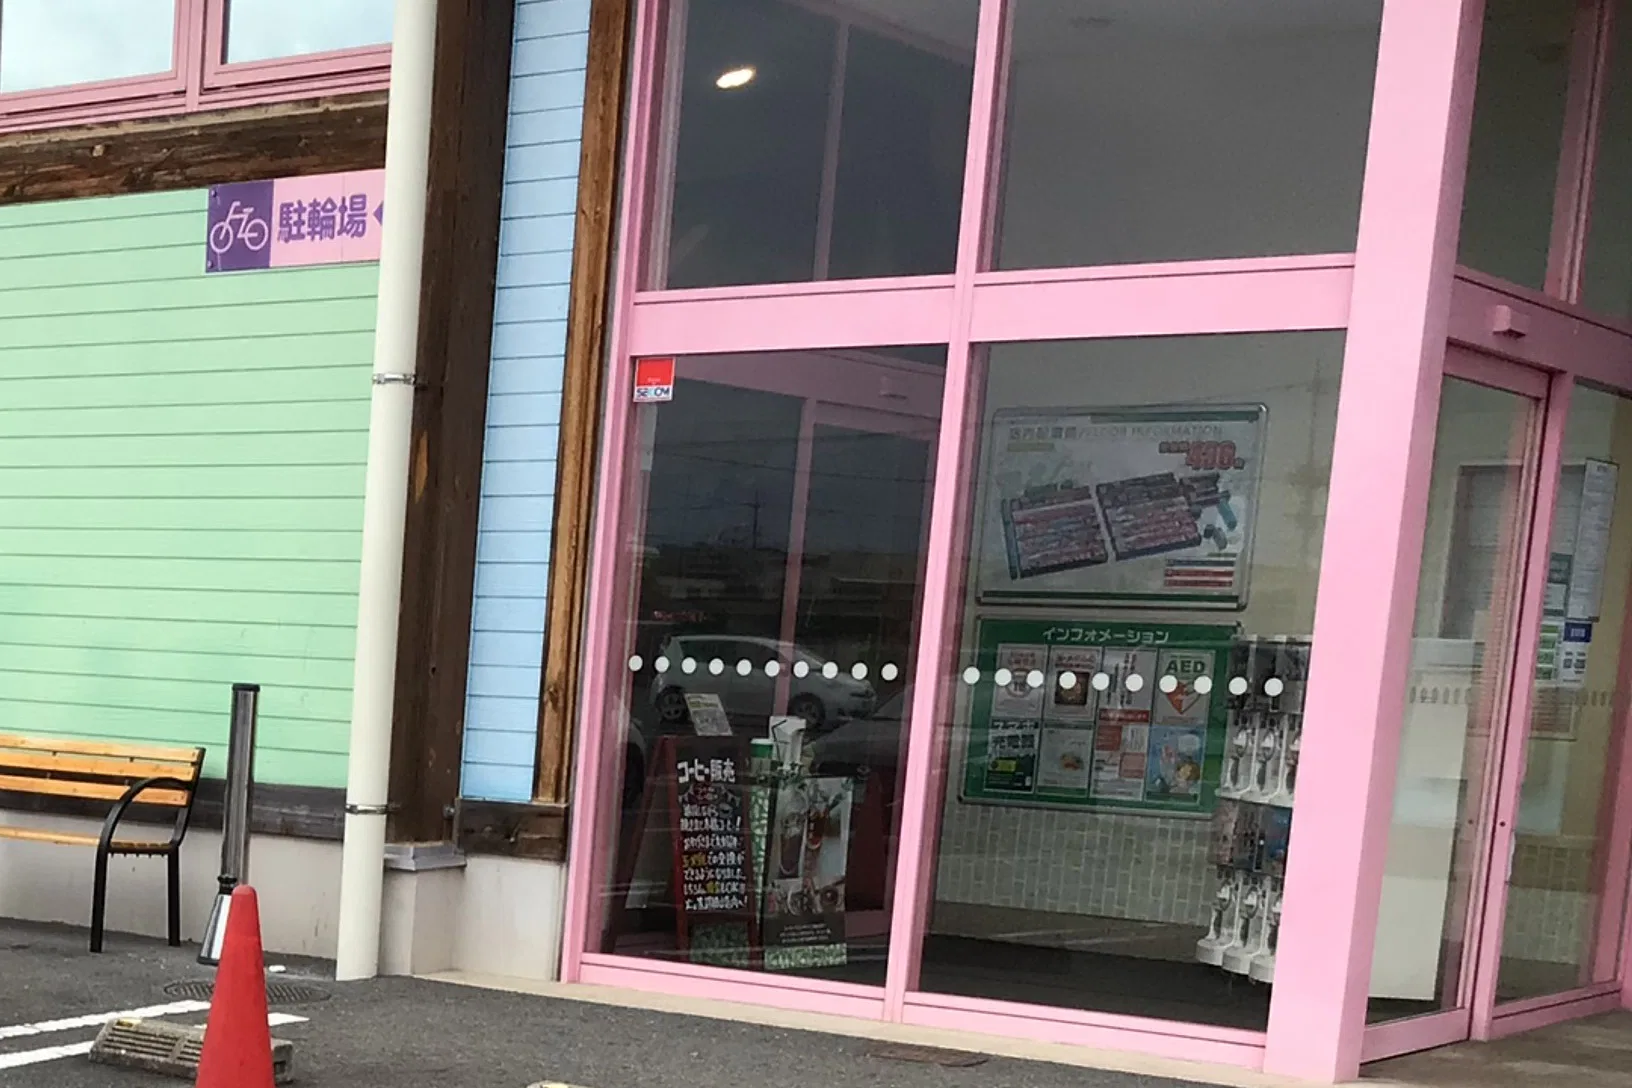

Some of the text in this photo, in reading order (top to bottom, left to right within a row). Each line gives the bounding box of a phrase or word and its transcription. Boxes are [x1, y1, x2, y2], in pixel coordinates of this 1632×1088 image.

[277, 194, 367, 244] 駐輪場
[1043, 626, 1170, 644] インフォメーション
[1165, 660, 1206, 674] AED
